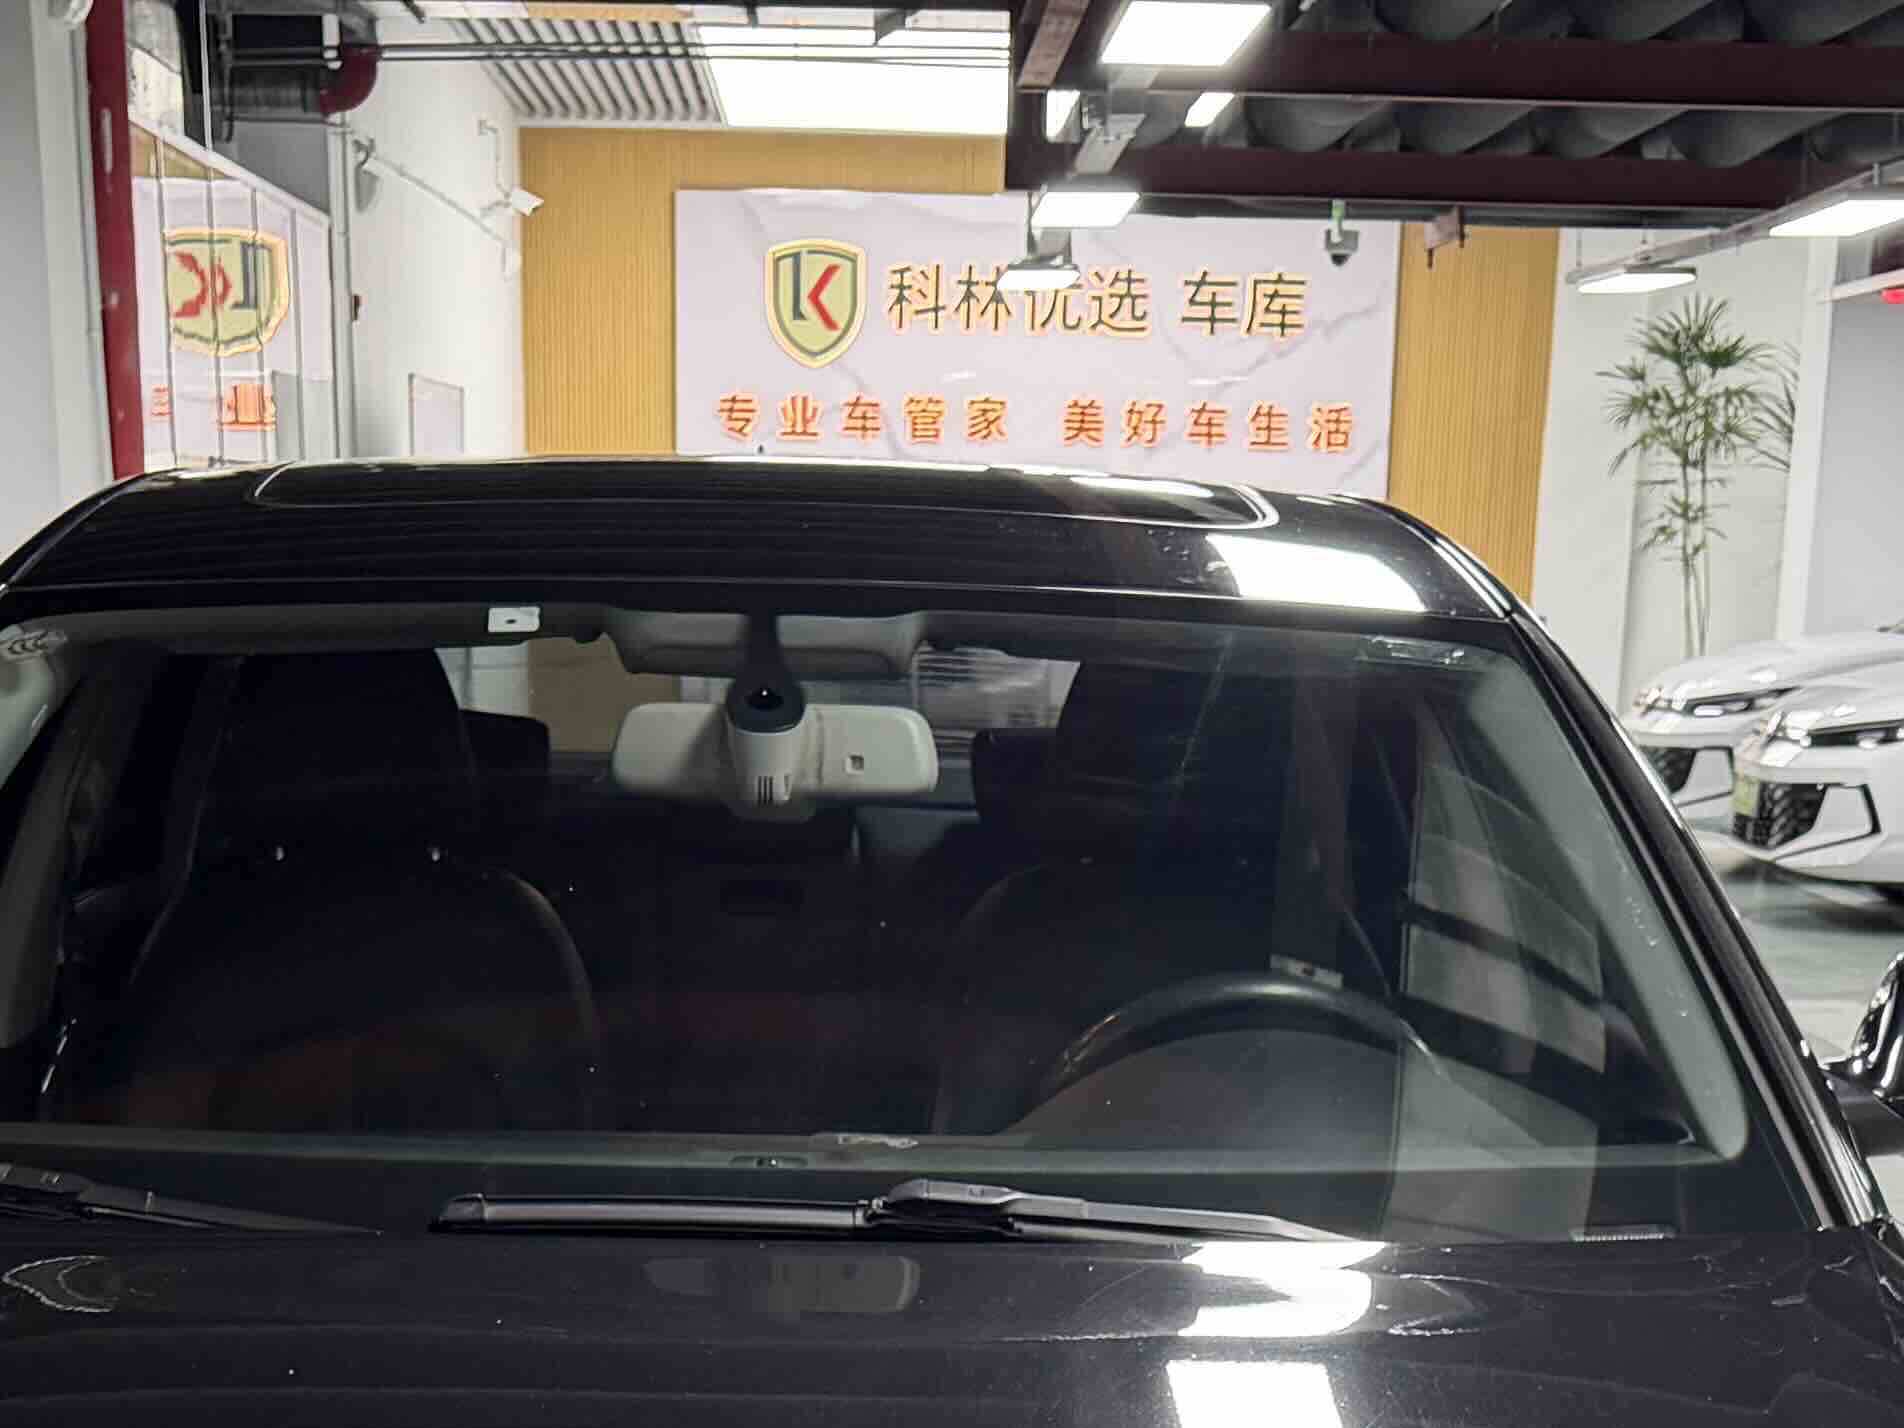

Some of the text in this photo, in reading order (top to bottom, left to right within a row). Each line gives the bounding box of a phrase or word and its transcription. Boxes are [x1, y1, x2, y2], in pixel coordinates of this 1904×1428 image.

[886, 262, 1310, 337] 科林优选 车库
[717, 391, 1356, 452] 专业车管家 美好车生活
